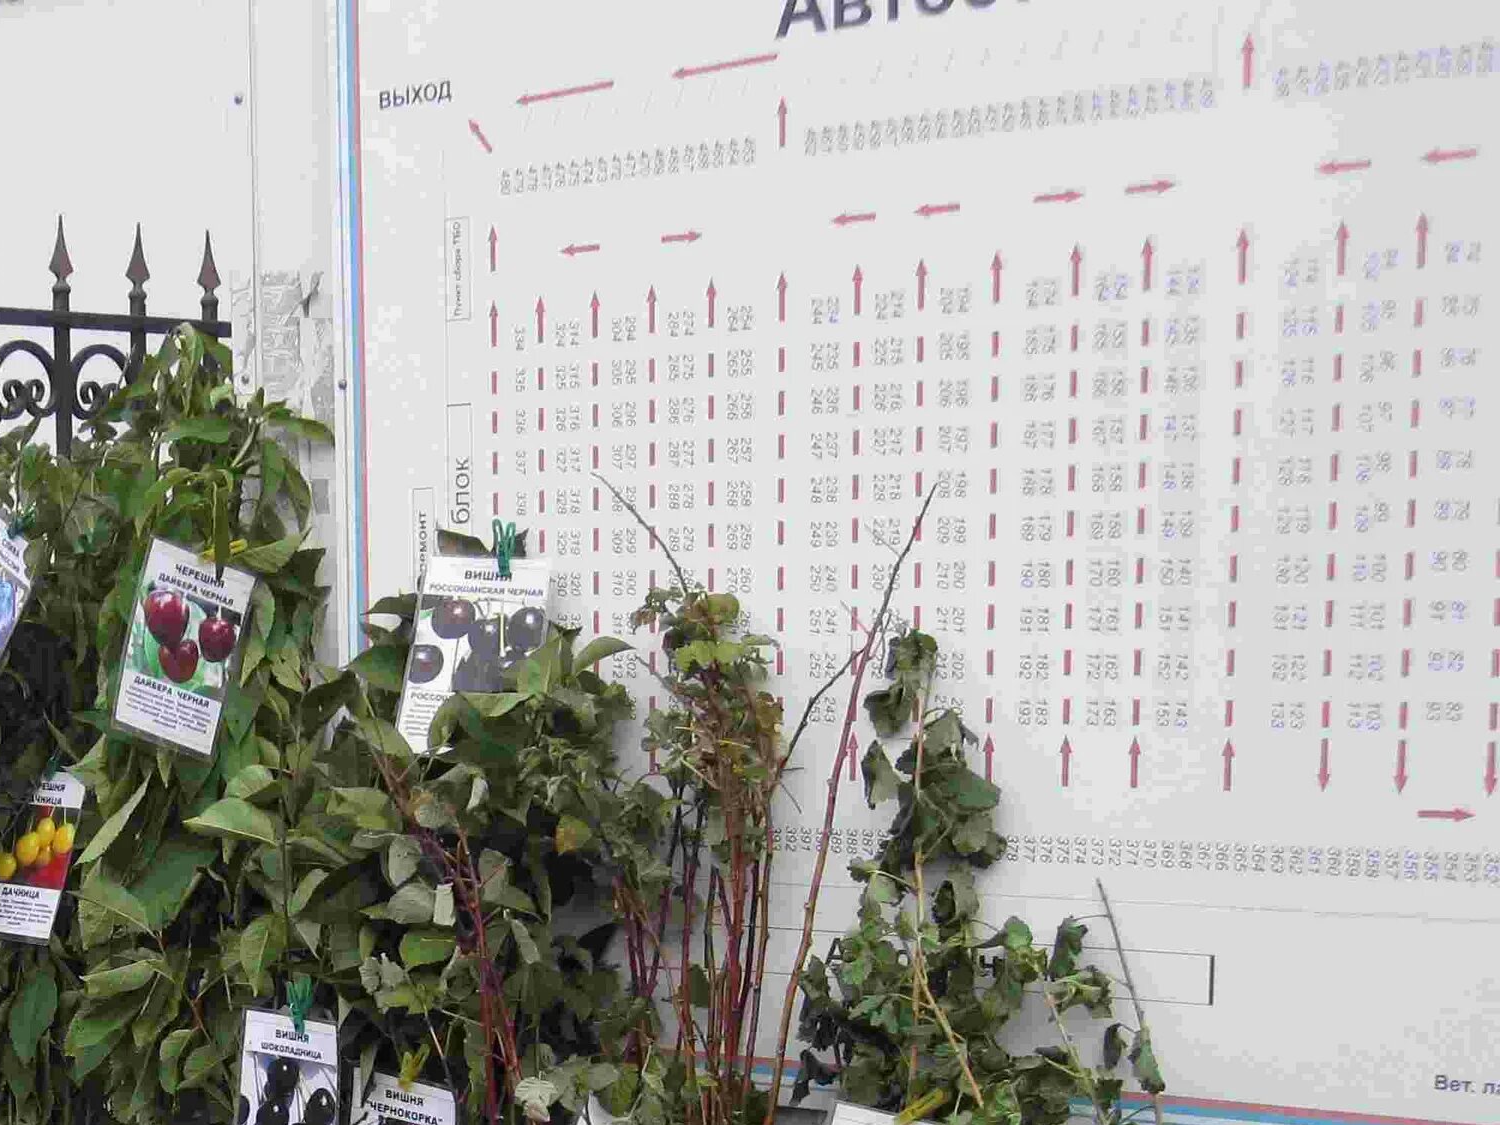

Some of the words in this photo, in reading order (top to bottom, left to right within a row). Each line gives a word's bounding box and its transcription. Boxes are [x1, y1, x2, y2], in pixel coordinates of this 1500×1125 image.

[379, 80, 452, 110] ВЫХОД
[514, 327, 526, 352] 334
[667, 354, 680, 382] 285
[682, 354, 695, 381] 275
[726, 350, 739, 378] 265
[740, 348, 753, 377] 255
[810, 343, 825, 371] 245
[515, 368, 526, 393] 335
[555, 365, 567, 391] 325
[569, 364, 581, 389] 315
[611, 359, 623, 386] 305
[625, 359, 637, 385] 295
[611, 403, 623, 428] 306
[625, 401, 637, 427] 296
[668, 397, 680, 425] 286
[726, 393, 739, 421] 266
[810, 388, 824, 415] 246
[515, 409, 527, 435] 336
[555, 407, 567, 432] 326
[569, 405, 581, 431] 316
[682, 440, 695, 467] 277
[726, 437, 739, 465] 267
[740, 437, 753, 463] 257
[810, 432, 824, 461] 247
[825, 431, 839, 459] 237
[873, 428, 887, 457] 227
[889, 427, 904, 456] 217
[938, 425, 952, 454] 207
[954, 426, 969, 454] 197
[515, 450, 527, 476] 337
[555, 449, 568, 474] 327
[569, 447, 582, 473] 317
[611, 445, 624, 471] 307
[625, 443, 637, 469] 297
[668, 441, 681, 468] 287
[451, 455, 470, 524] блок
[668, 483, 681, 510] 288
[682, 483, 695, 510] 278
[726, 480, 739, 508] 268
[739, 480, 753, 508] 258
[810, 477, 824, 504] 248
[825, 475, 839, 504] 238
[872, 473, 886, 502] 228
[888, 473, 902, 501] 218
[954, 470, 969, 499] 198
[515, 491, 527, 517] 338
[555, 489, 568, 515] 328
[569, 489, 581, 515] 318
[556, 531, 568, 556] 329
[569, 531, 582, 556] 319
[611, 529, 624, 555] 309
[625, 529, 637, 555] 299
[682, 525, 695, 553] 279
[726, 523, 739, 551] 269
[739, 523, 753, 551] 259
[809, 521, 823, 549] 249
[824, 520, 839, 548] 239
[936, 516, 951, 545] 209
[952, 517, 967, 544] 199
[175, 563, 225, 589] ЧЕРЕШНЯ
[569, 571, 582, 597] 320
[612, 570, 624, 597] 310
[625, 570, 638, 596] 300
[739, 566, 752, 594] 260
[809, 564, 823, 593] 250
[824, 564, 838, 593] 240
[936, 561, 951, 590] 210
[952, 560, 967, 590] 200
[1020, 560, 1035, 589] 190
[1037, 561, 1052, 589] 180
[200, 586, 234, 607] ЧЕРНАЯ
[809, 609, 822, 635] 251
[824, 608, 838, 635] 241
[935, 606, 950, 632] 211
[951, 606, 966, 634] 201
[1019, 607, 1034, 634] 191
[808, 652, 822, 680] 252
[951, 651, 965, 681] 202
[1018, 654, 1033, 681] 192
[1035, 653, 1050, 681] 182
[177, 690, 210, 709] ЧЕРНАЯ
[1017, 699, 1032, 726] 193
[1034, 698, 1049, 726] 183
[784, 825, 798, 853] 392
[846, 828, 861, 857] 388
[861, 828, 874, 858] 387
[1003, 835, 1020, 862] 378
[1023, 835, 1037, 864] 377
[1039, 835, 1054, 864] 376
[1055, 836, 1071, 865] 375
[1073, 836, 1088, 865] 374
[1090, 837, 1105, 866] 373
[1108, 838, 1123, 867] 372
[1126, 839, 1140, 866] 371
[1143, 839, 1158, 869] 370
[1160, 840, 1176, 869] 369
[1177, 840, 1194, 870] 368
[1196, 841, 1212, 871] 367
[1214, 842, 1231, 871] 366
[275, 1028, 310, 1045] ВИШНЯ
[260, 1042, 322, 1060] ШОКОЛАДНИЦА
[1433, 1074, 1476, 1093] Вет.
[385, 1089, 424, 1107] ВИШНЯ
